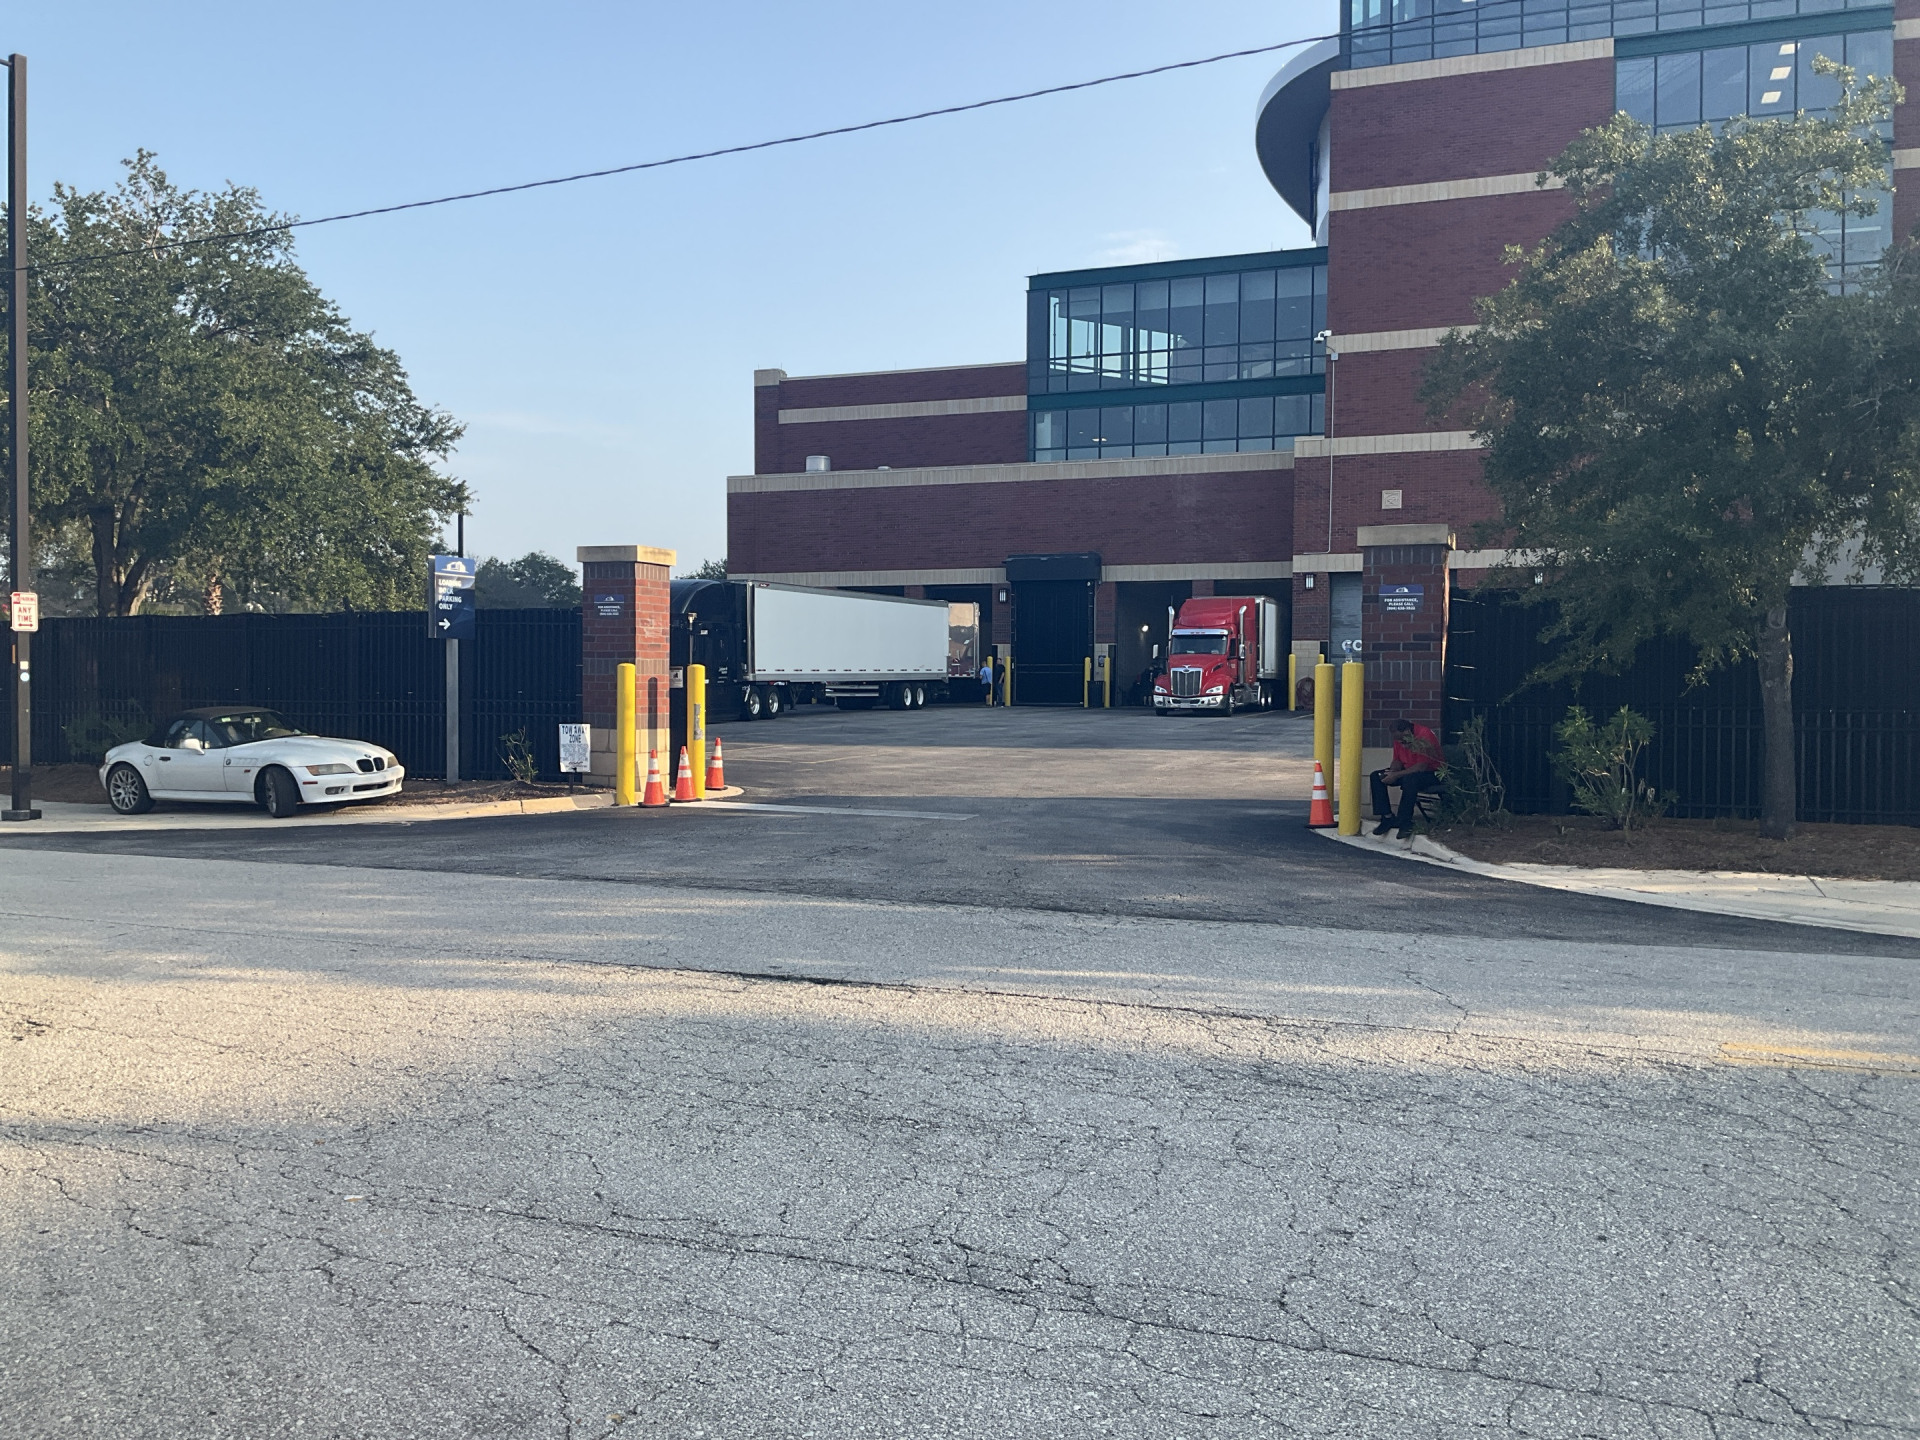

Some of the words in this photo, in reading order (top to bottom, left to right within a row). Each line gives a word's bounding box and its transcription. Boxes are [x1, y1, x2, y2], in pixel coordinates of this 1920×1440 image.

[438, 579, 461, 587] LOADING
[438, 587, 454, 595] DOCK
[438, 595, 462, 603] PARKING
[562, 725, 573, 734] TOW
[569, 734, 581, 743] ZONE
